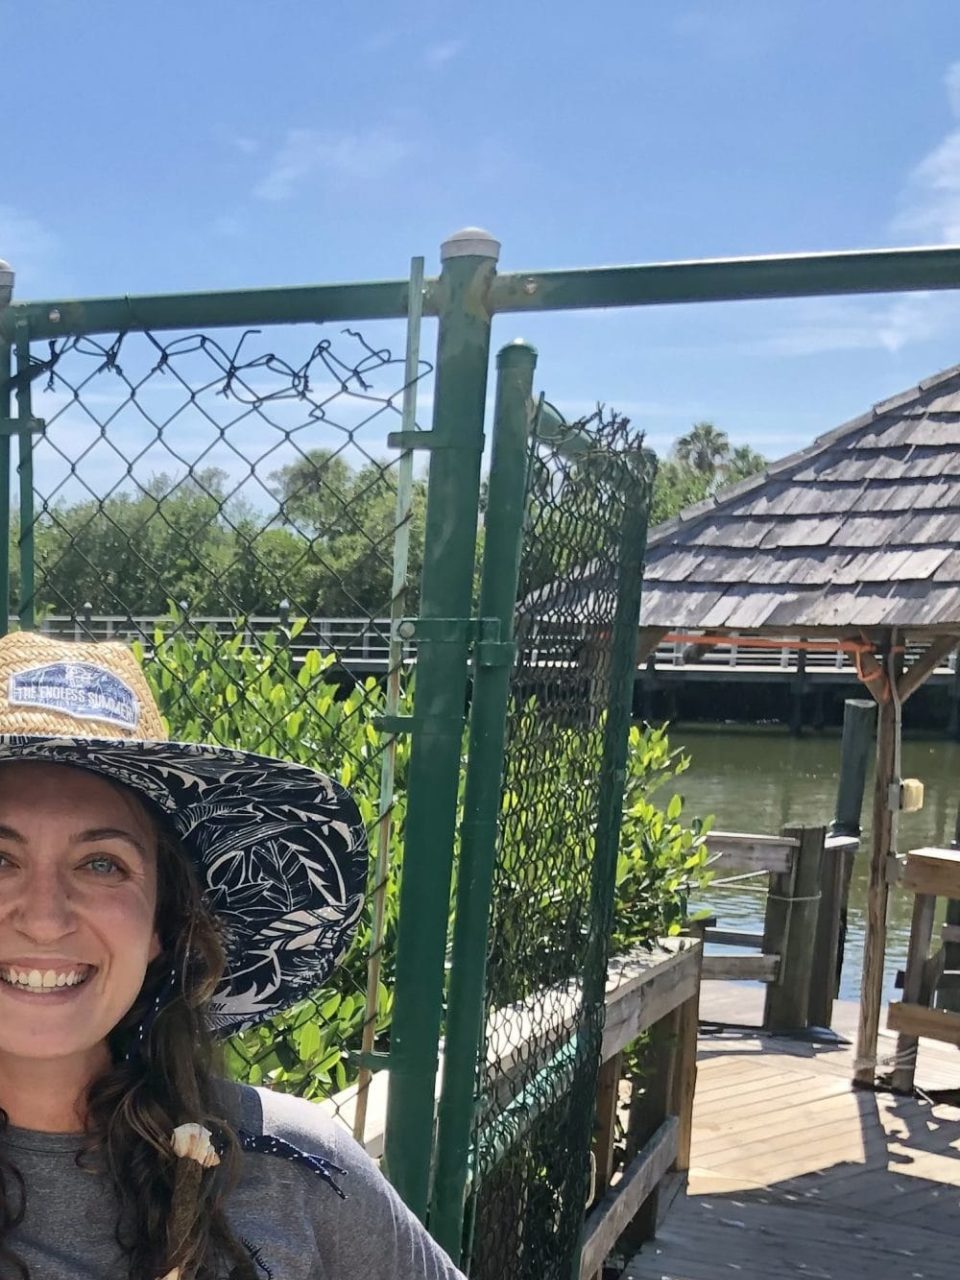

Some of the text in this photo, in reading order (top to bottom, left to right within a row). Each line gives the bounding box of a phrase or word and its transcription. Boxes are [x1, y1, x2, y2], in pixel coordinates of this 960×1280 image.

[18, 687, 132, 721] THE ENDLESS SUMMER
